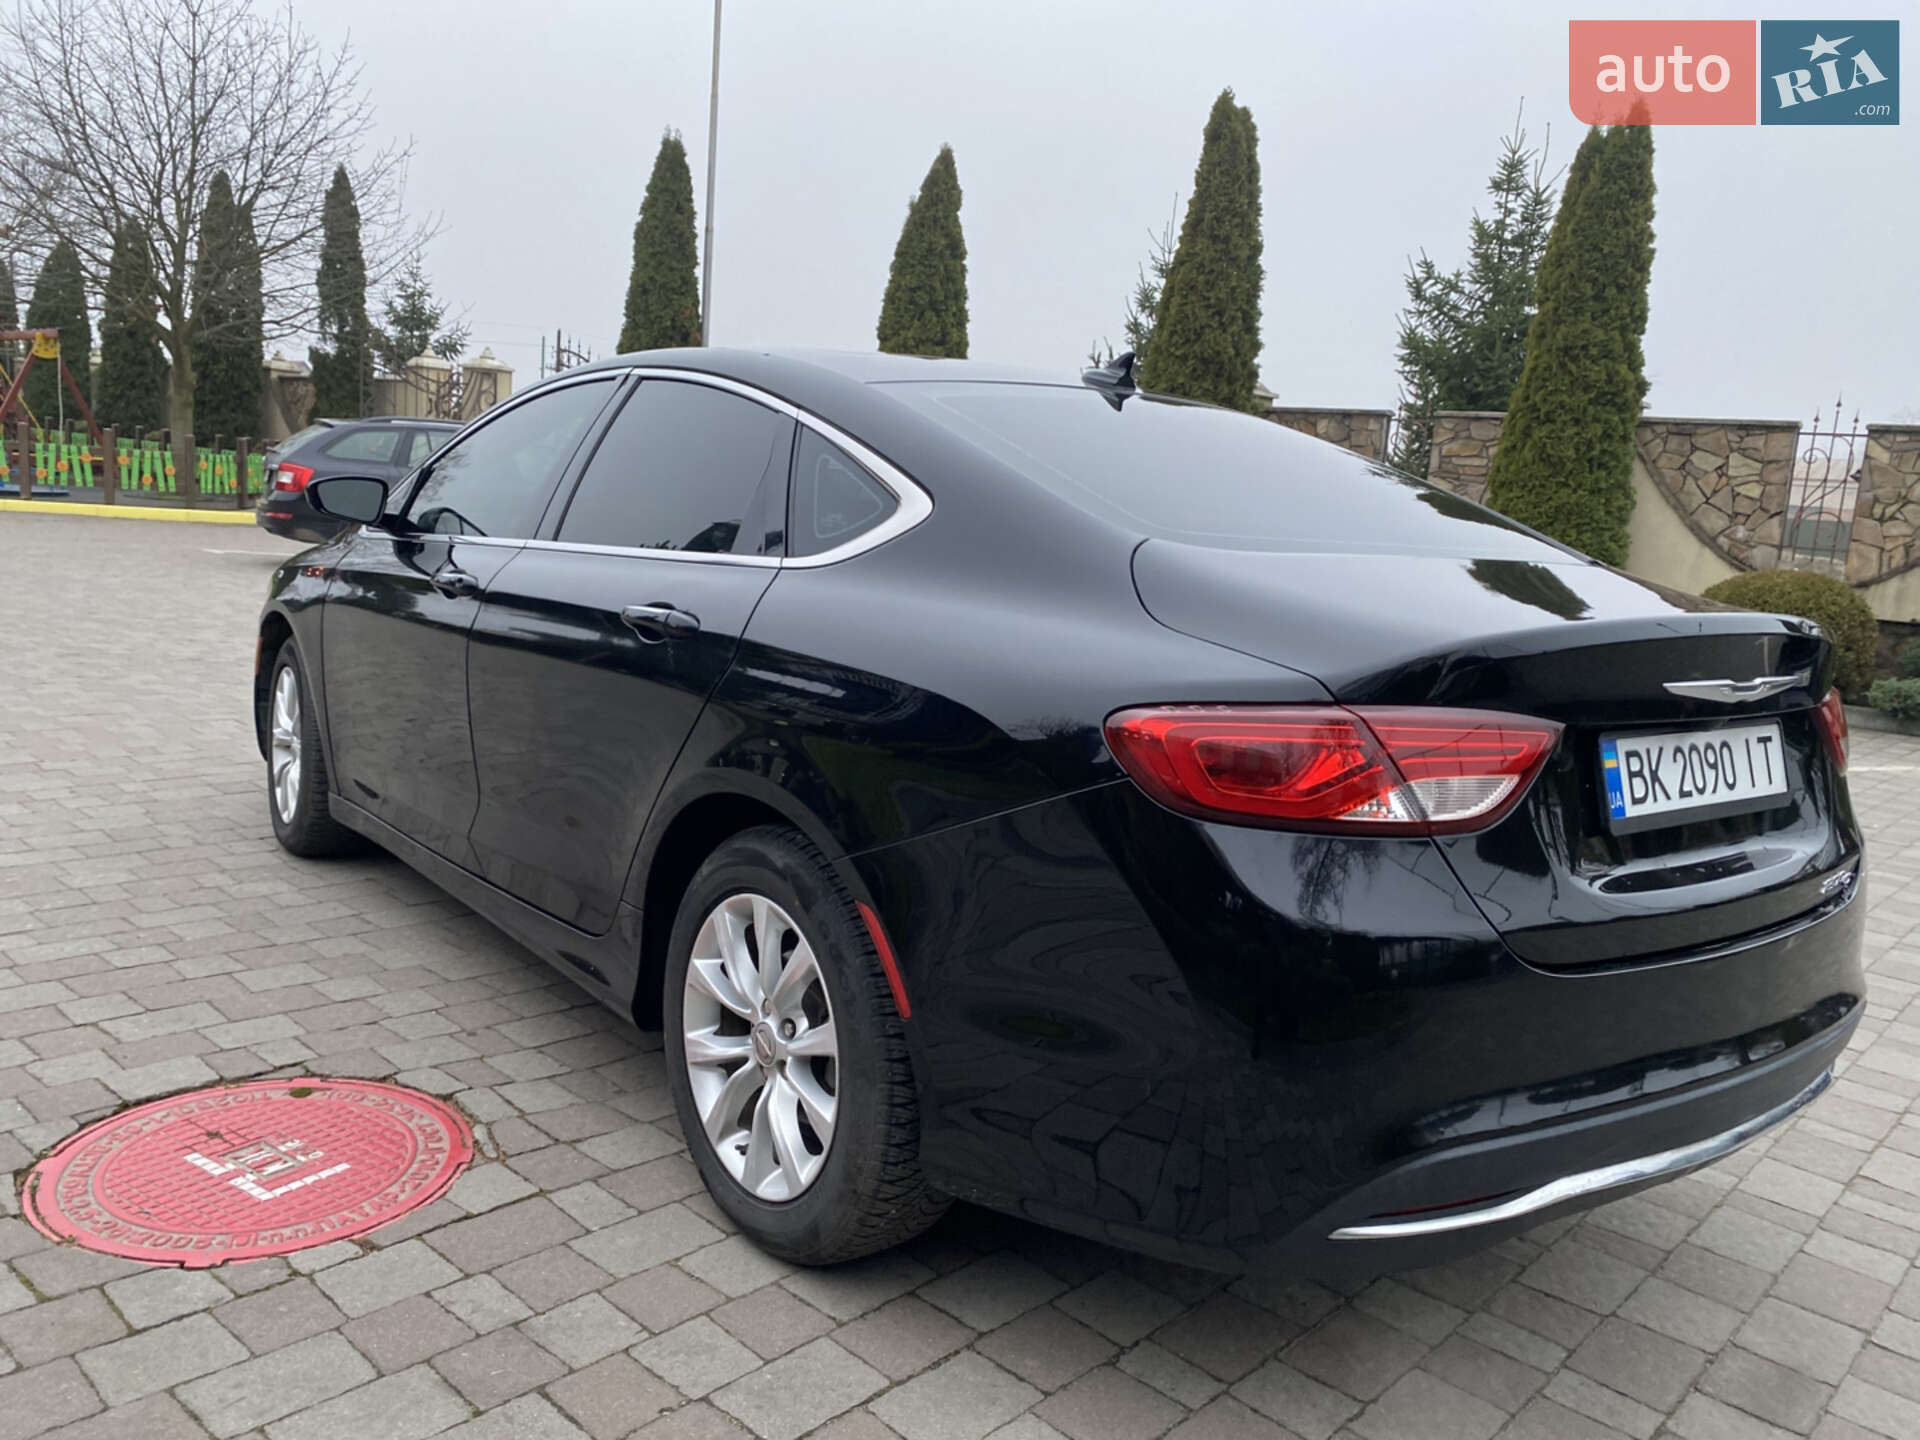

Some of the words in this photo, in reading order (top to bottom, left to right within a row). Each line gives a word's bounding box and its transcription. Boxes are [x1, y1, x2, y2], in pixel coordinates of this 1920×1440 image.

[1624, 746, 1671, 805] BK
[1673, 739, 1737, 799] 2090
[1744, 735, 1773, 788] IT
[1608, 791, 1624, 809] UA
